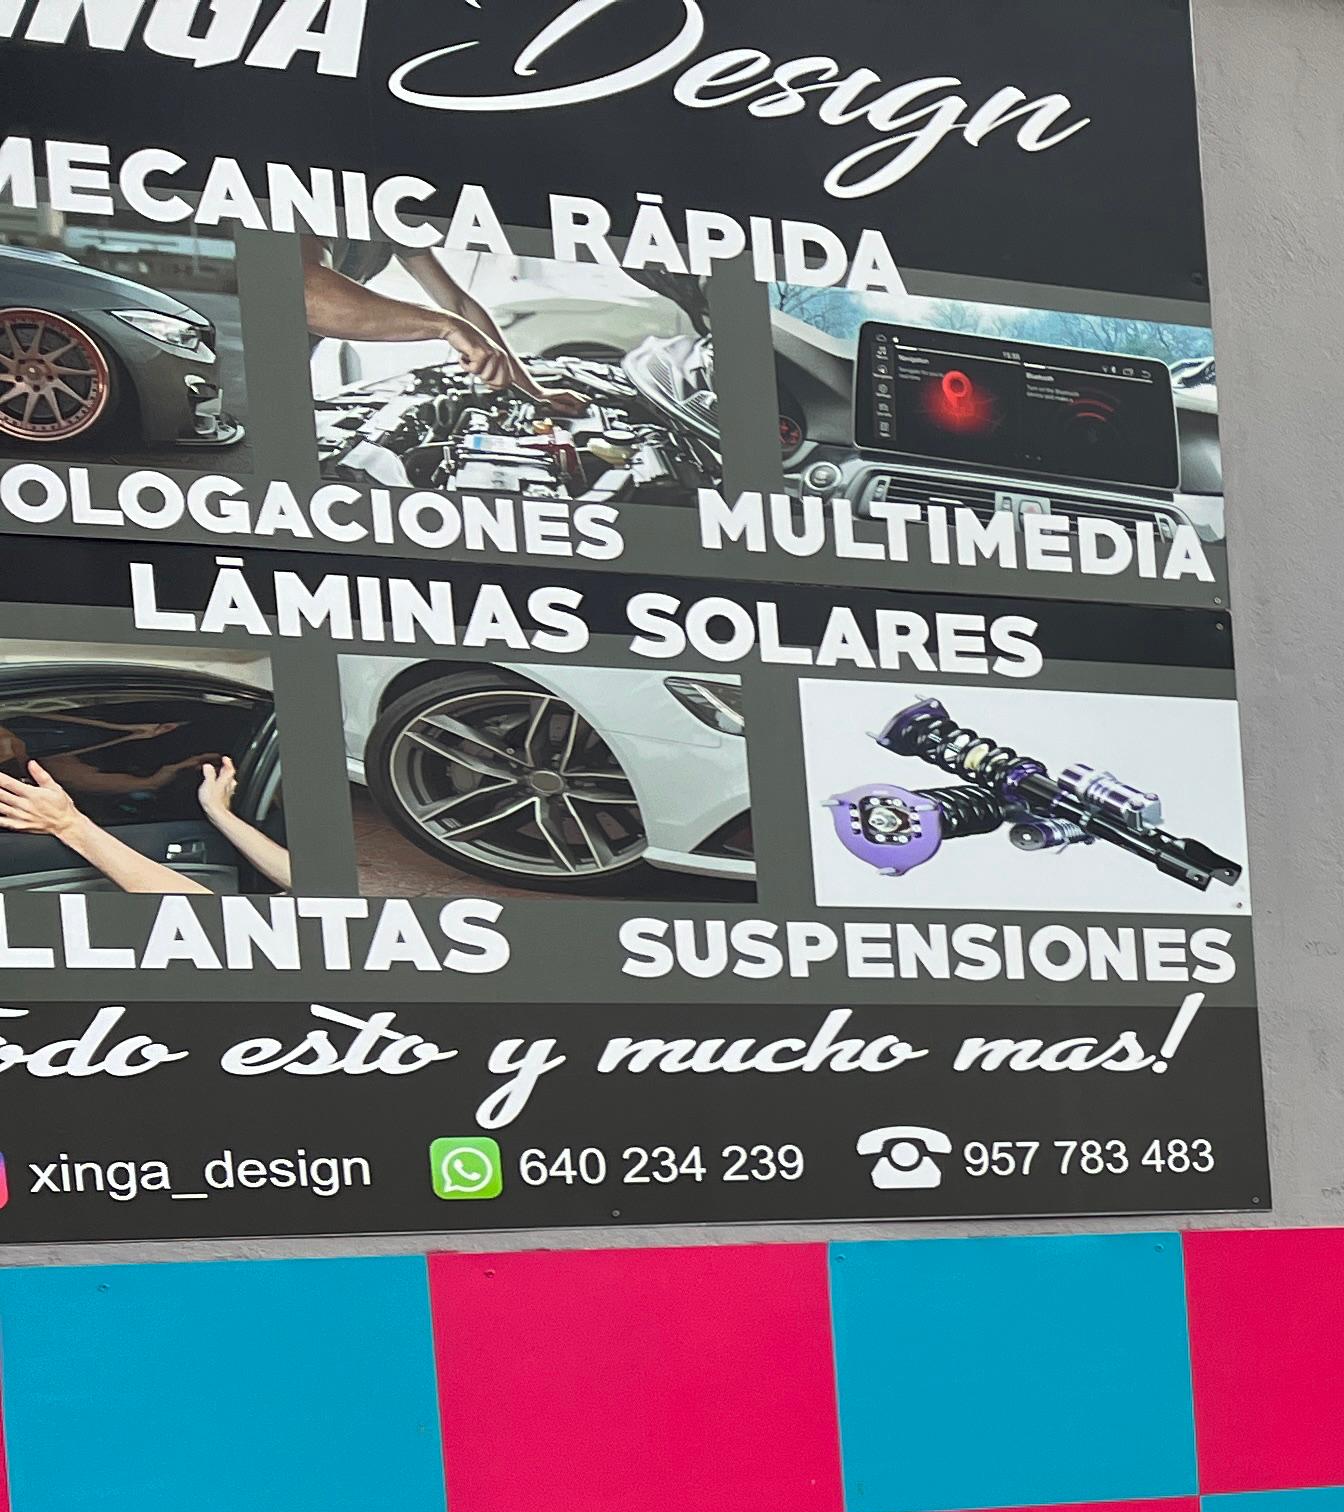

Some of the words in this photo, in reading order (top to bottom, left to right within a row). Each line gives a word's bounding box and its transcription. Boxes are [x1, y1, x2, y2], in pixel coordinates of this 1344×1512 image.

[388, 0, 1091, 199] Design
[1, 463, 625, 560] OLOGACIONES
[625, 592, 1044, 679] SOLARES
[618, 917, 1237, 984] SUSPENSIONES
[0, 1005, 190, 1078] odo
[220, 1003, 459, 1076] esto
[475, 1037, 567, 1130] y
[597, 1008, 930, 1075] mucho
[953, 992, 1206, 1075] mas!
[28, 1148, 372, 1200] xinga_design
[519, 1147, 607, 1187] 640
[621, 1144, 707, 1184] 234
[721, 1143, 805, 1182] 239
[963, 1139, 1040, 1178] 957
[1054, 1138, 1130, 1176] 783
[1141, 1137, 1216, 1174] 483
